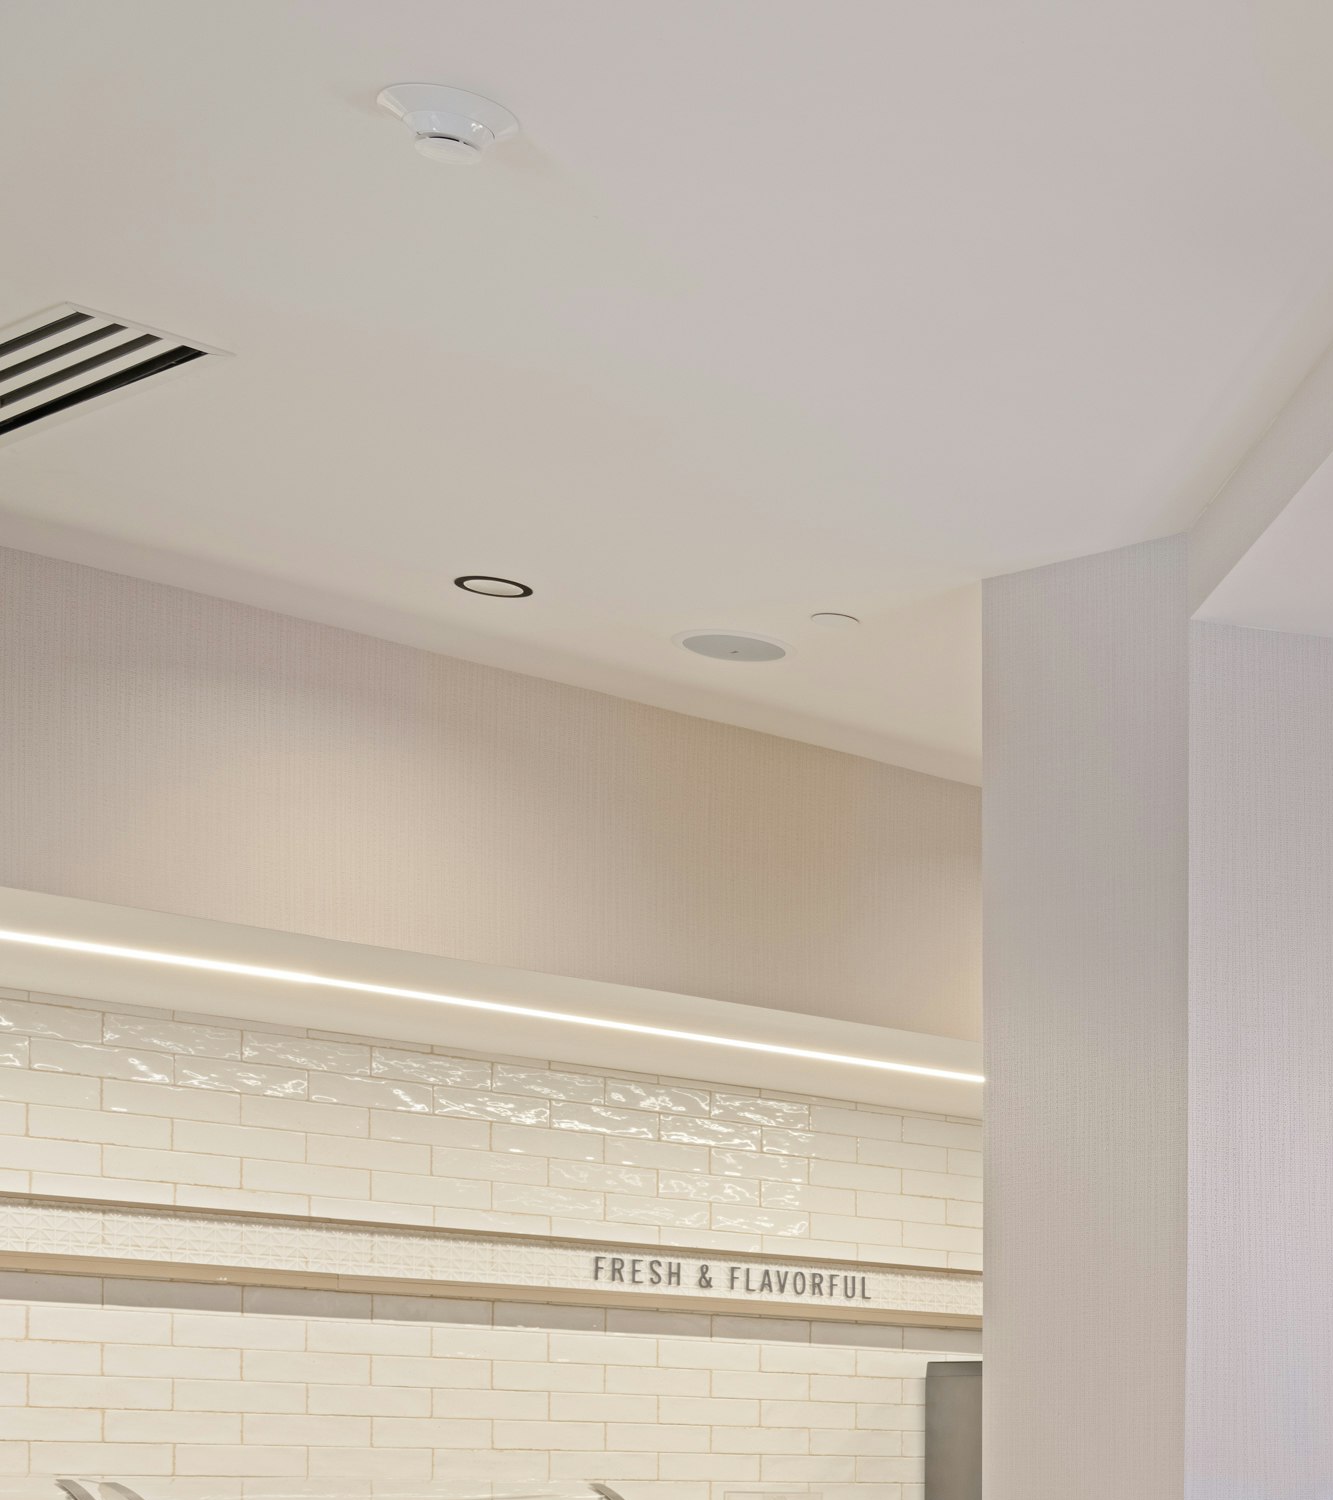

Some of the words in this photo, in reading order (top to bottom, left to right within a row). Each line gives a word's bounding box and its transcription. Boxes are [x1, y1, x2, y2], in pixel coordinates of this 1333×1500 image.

[592, 1255, 683, 1287] FRESH
[699, 1263, 714, 1290] &
[729, 1266, 873, 1301] FLAVORFUL
